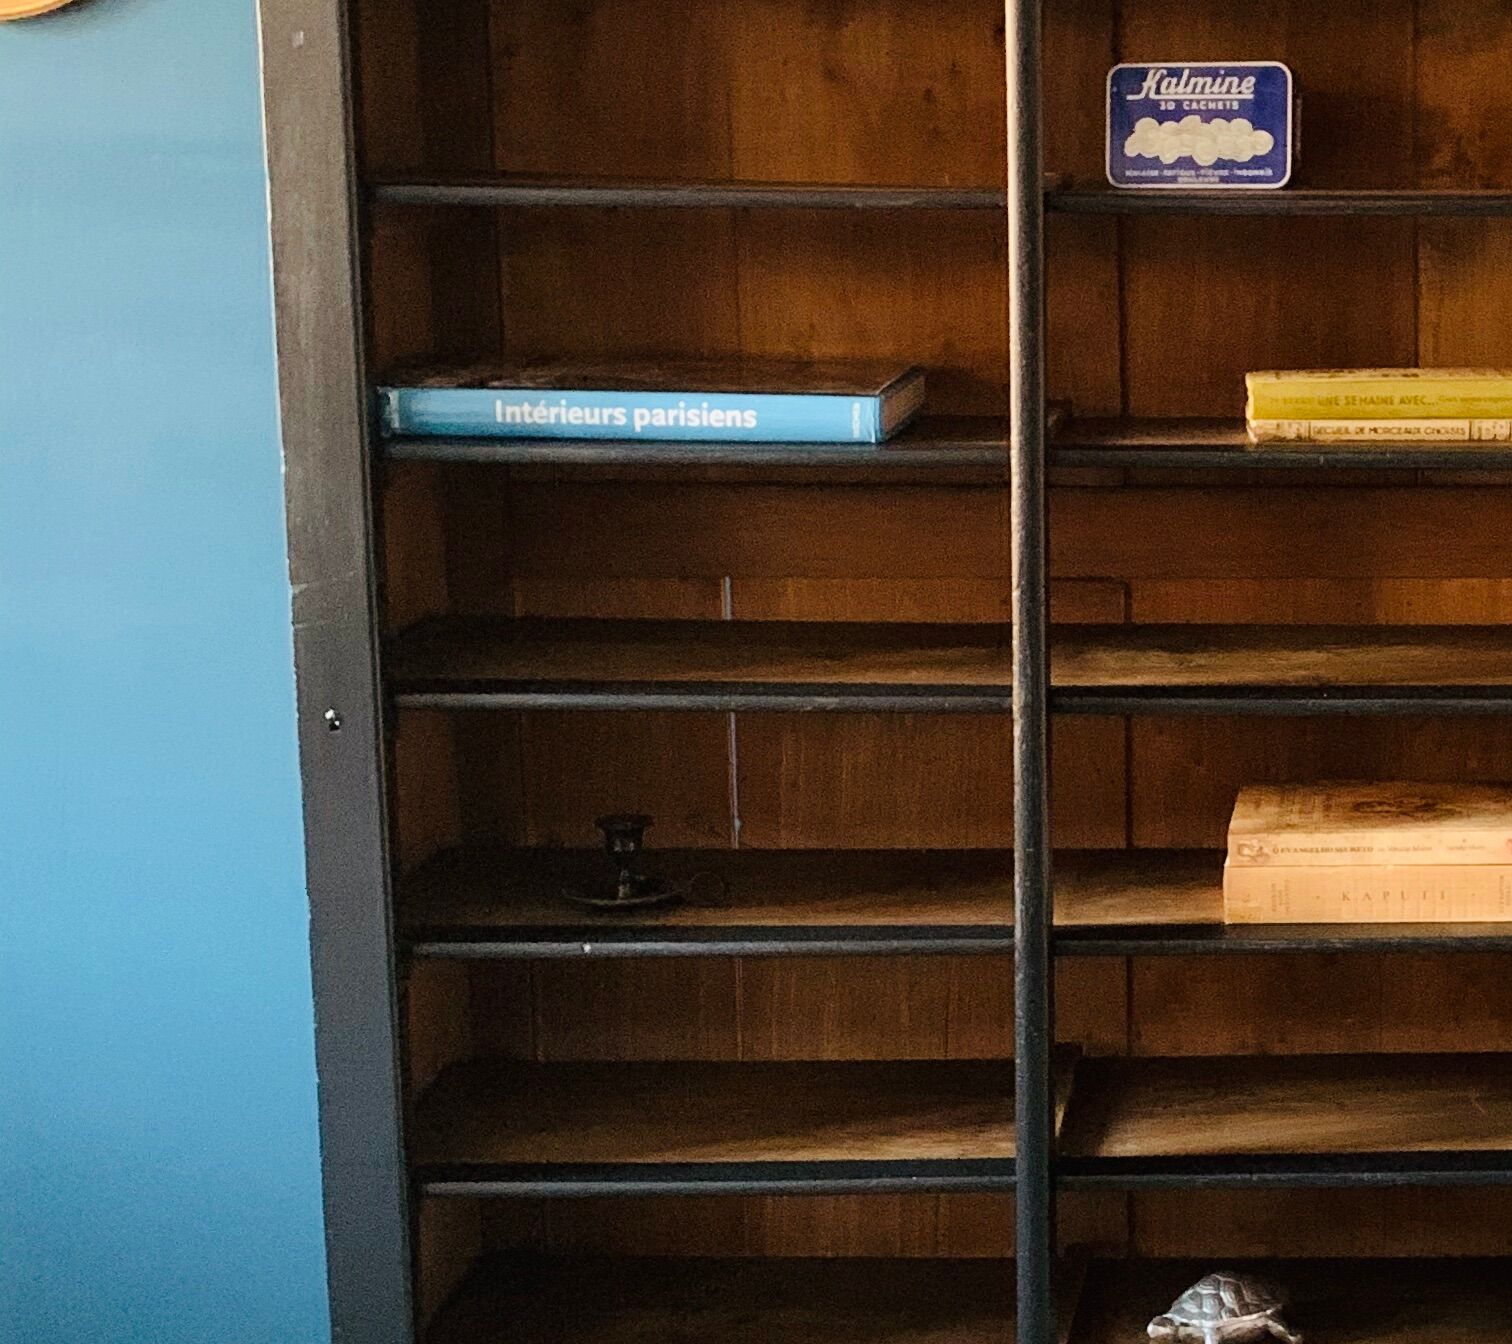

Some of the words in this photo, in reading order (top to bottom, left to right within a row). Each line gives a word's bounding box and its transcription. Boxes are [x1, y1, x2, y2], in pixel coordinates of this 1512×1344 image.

[1126, 68, 1257, 101] Kalmine
[1182, 100, 1241, 111] CACHETS
[1317, 395, 1340, 406] UNE
[1343, 394, 1395, 406] SEMAINE
[494, 399, 628, 427] Intérieurs
[633, 401, 758, 432] parisiens
[1354, 426, 1366, 436] DE
[1368, 426, 1422, 436] MORCEAUX
